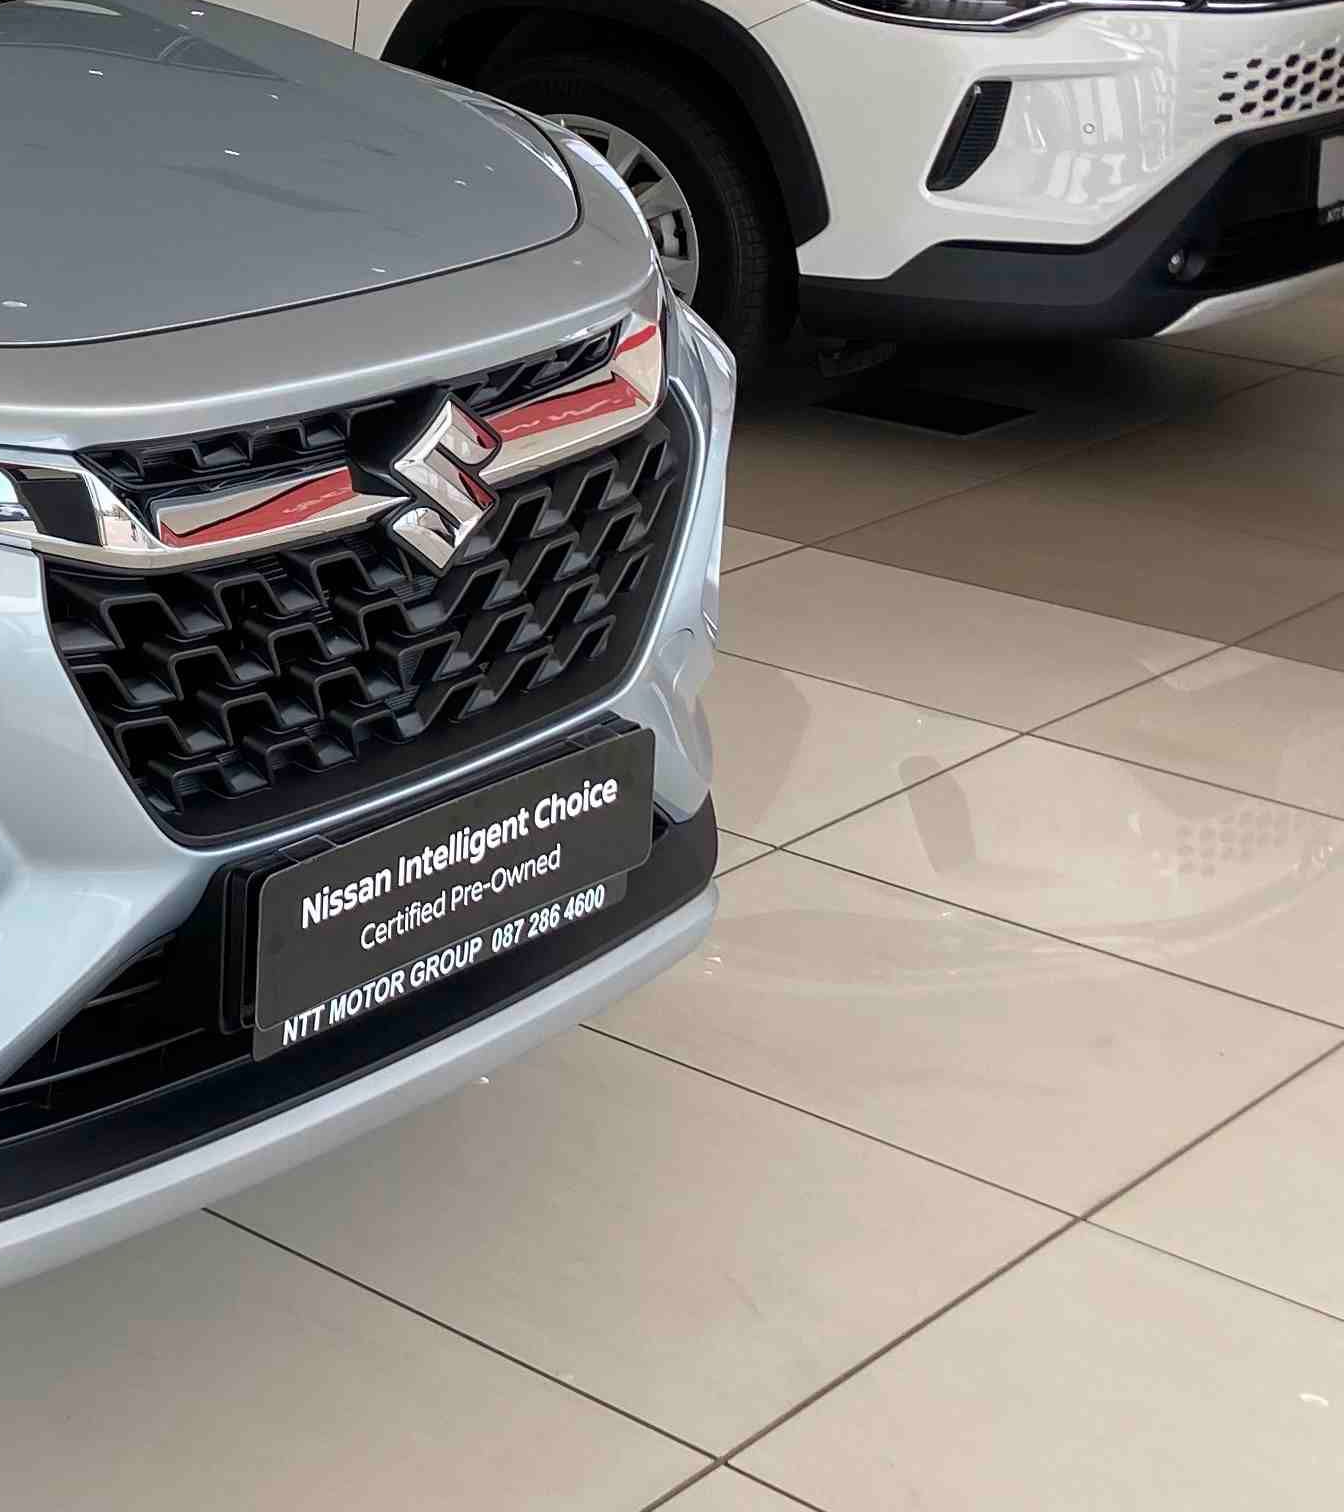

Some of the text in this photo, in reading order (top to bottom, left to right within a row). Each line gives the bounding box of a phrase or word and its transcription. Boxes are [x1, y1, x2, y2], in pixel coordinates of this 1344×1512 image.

[302, 778, 618, 929] Nissan Intelligent Choice
[360, 843, 561, 950] Certified Pre-Owned
[282, 884, 605, 1046] NTT MOTOR GROUP 087 286 4600
